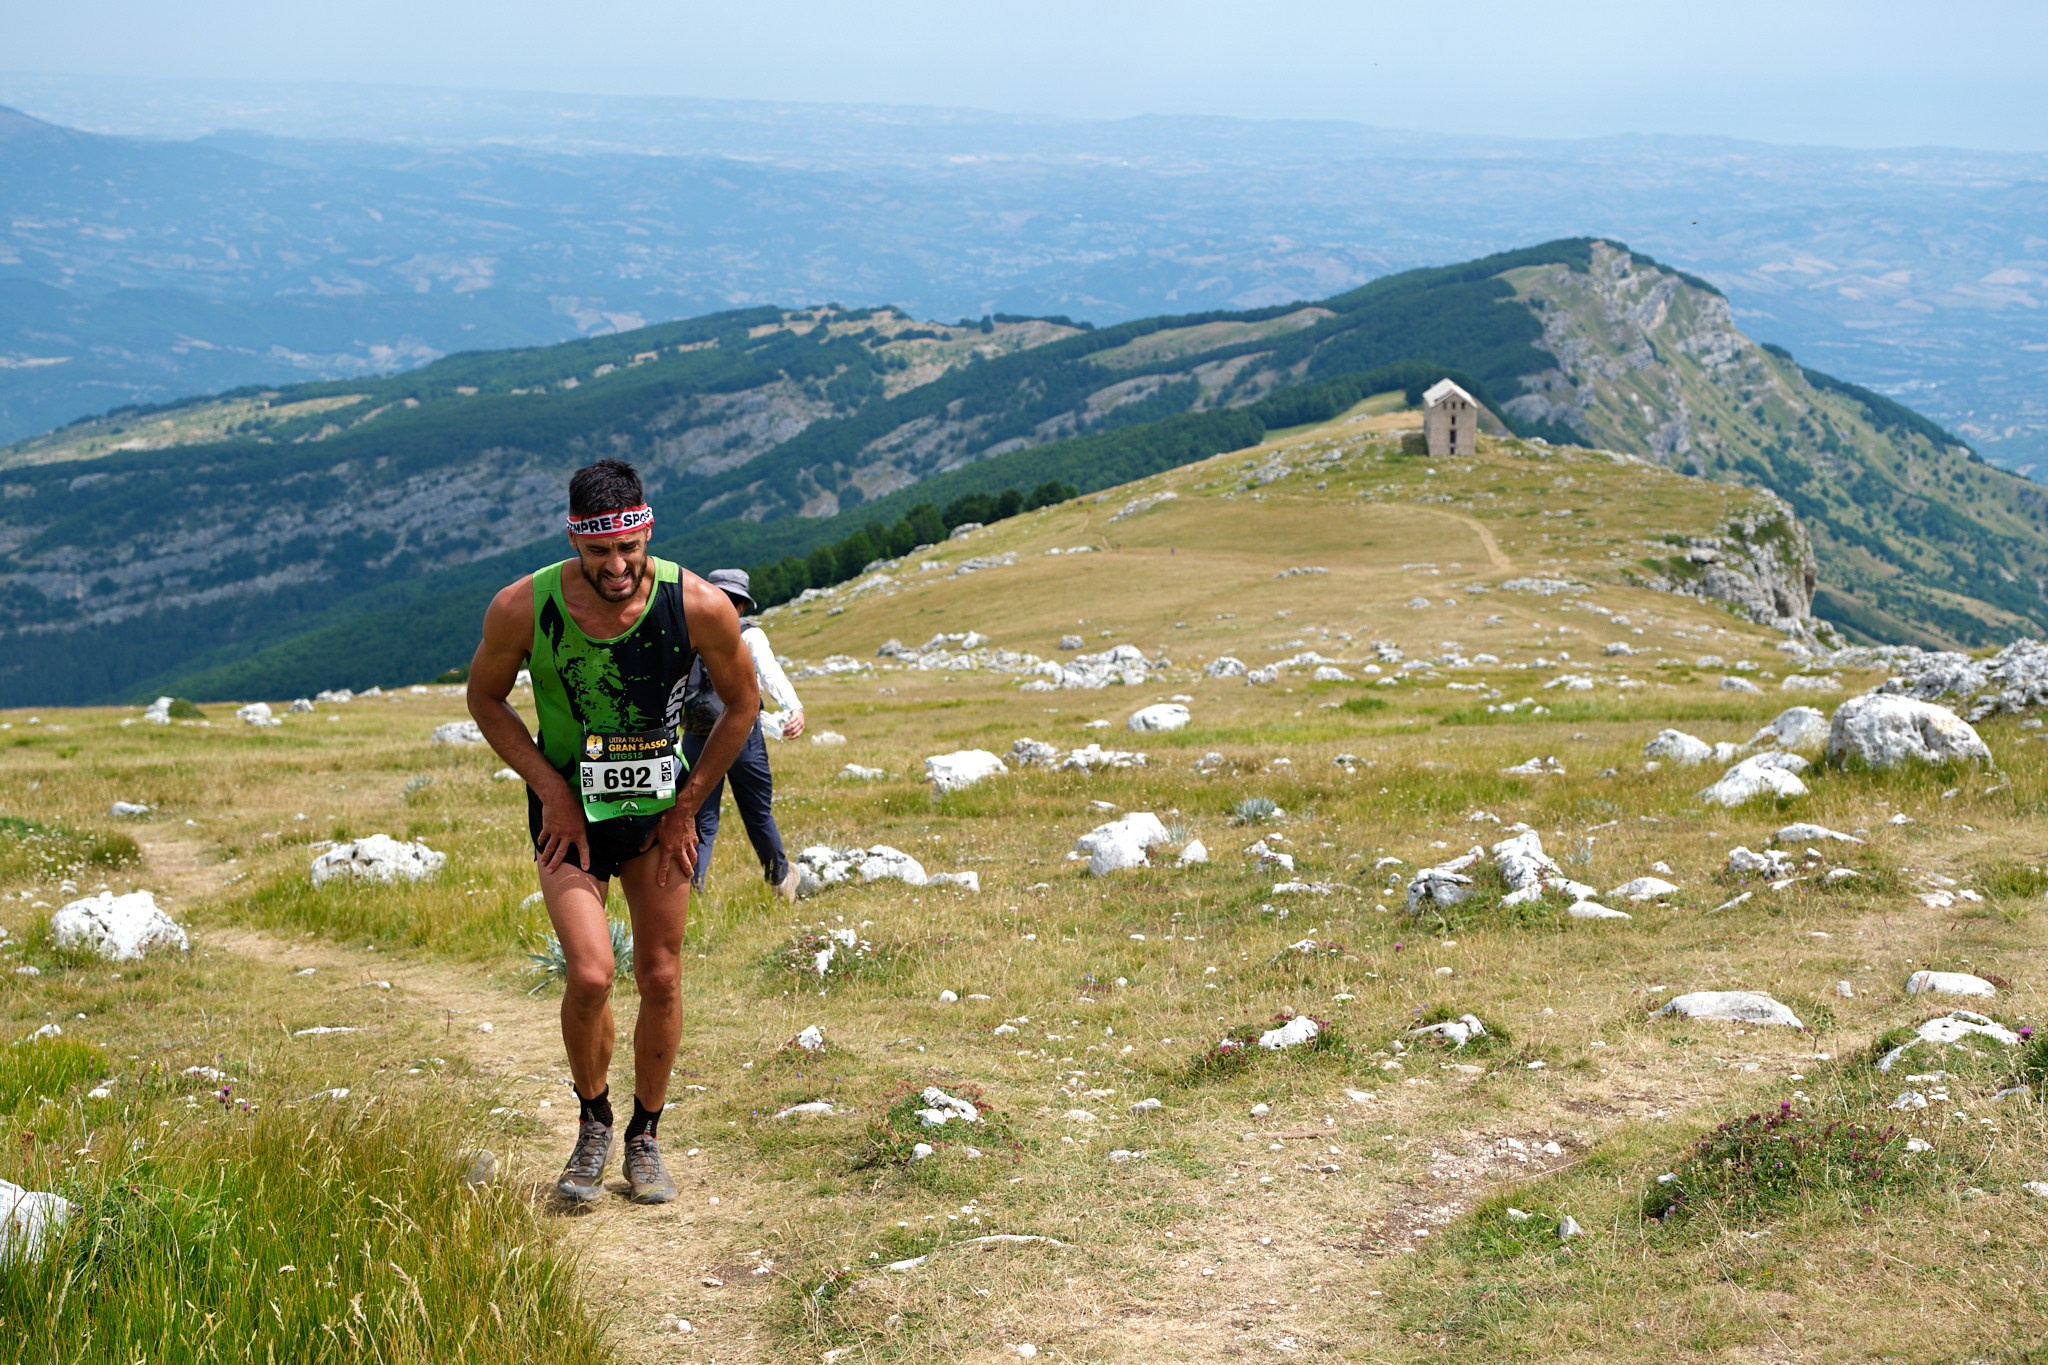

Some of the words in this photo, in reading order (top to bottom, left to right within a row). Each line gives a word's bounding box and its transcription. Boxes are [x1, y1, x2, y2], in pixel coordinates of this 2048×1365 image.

[608, 743, 636, 752] GRAN
[638, 738, 668, 751] SASSO
[609, 752, 643, 760] UTGS15
[603, 766, 652, 790] 692
